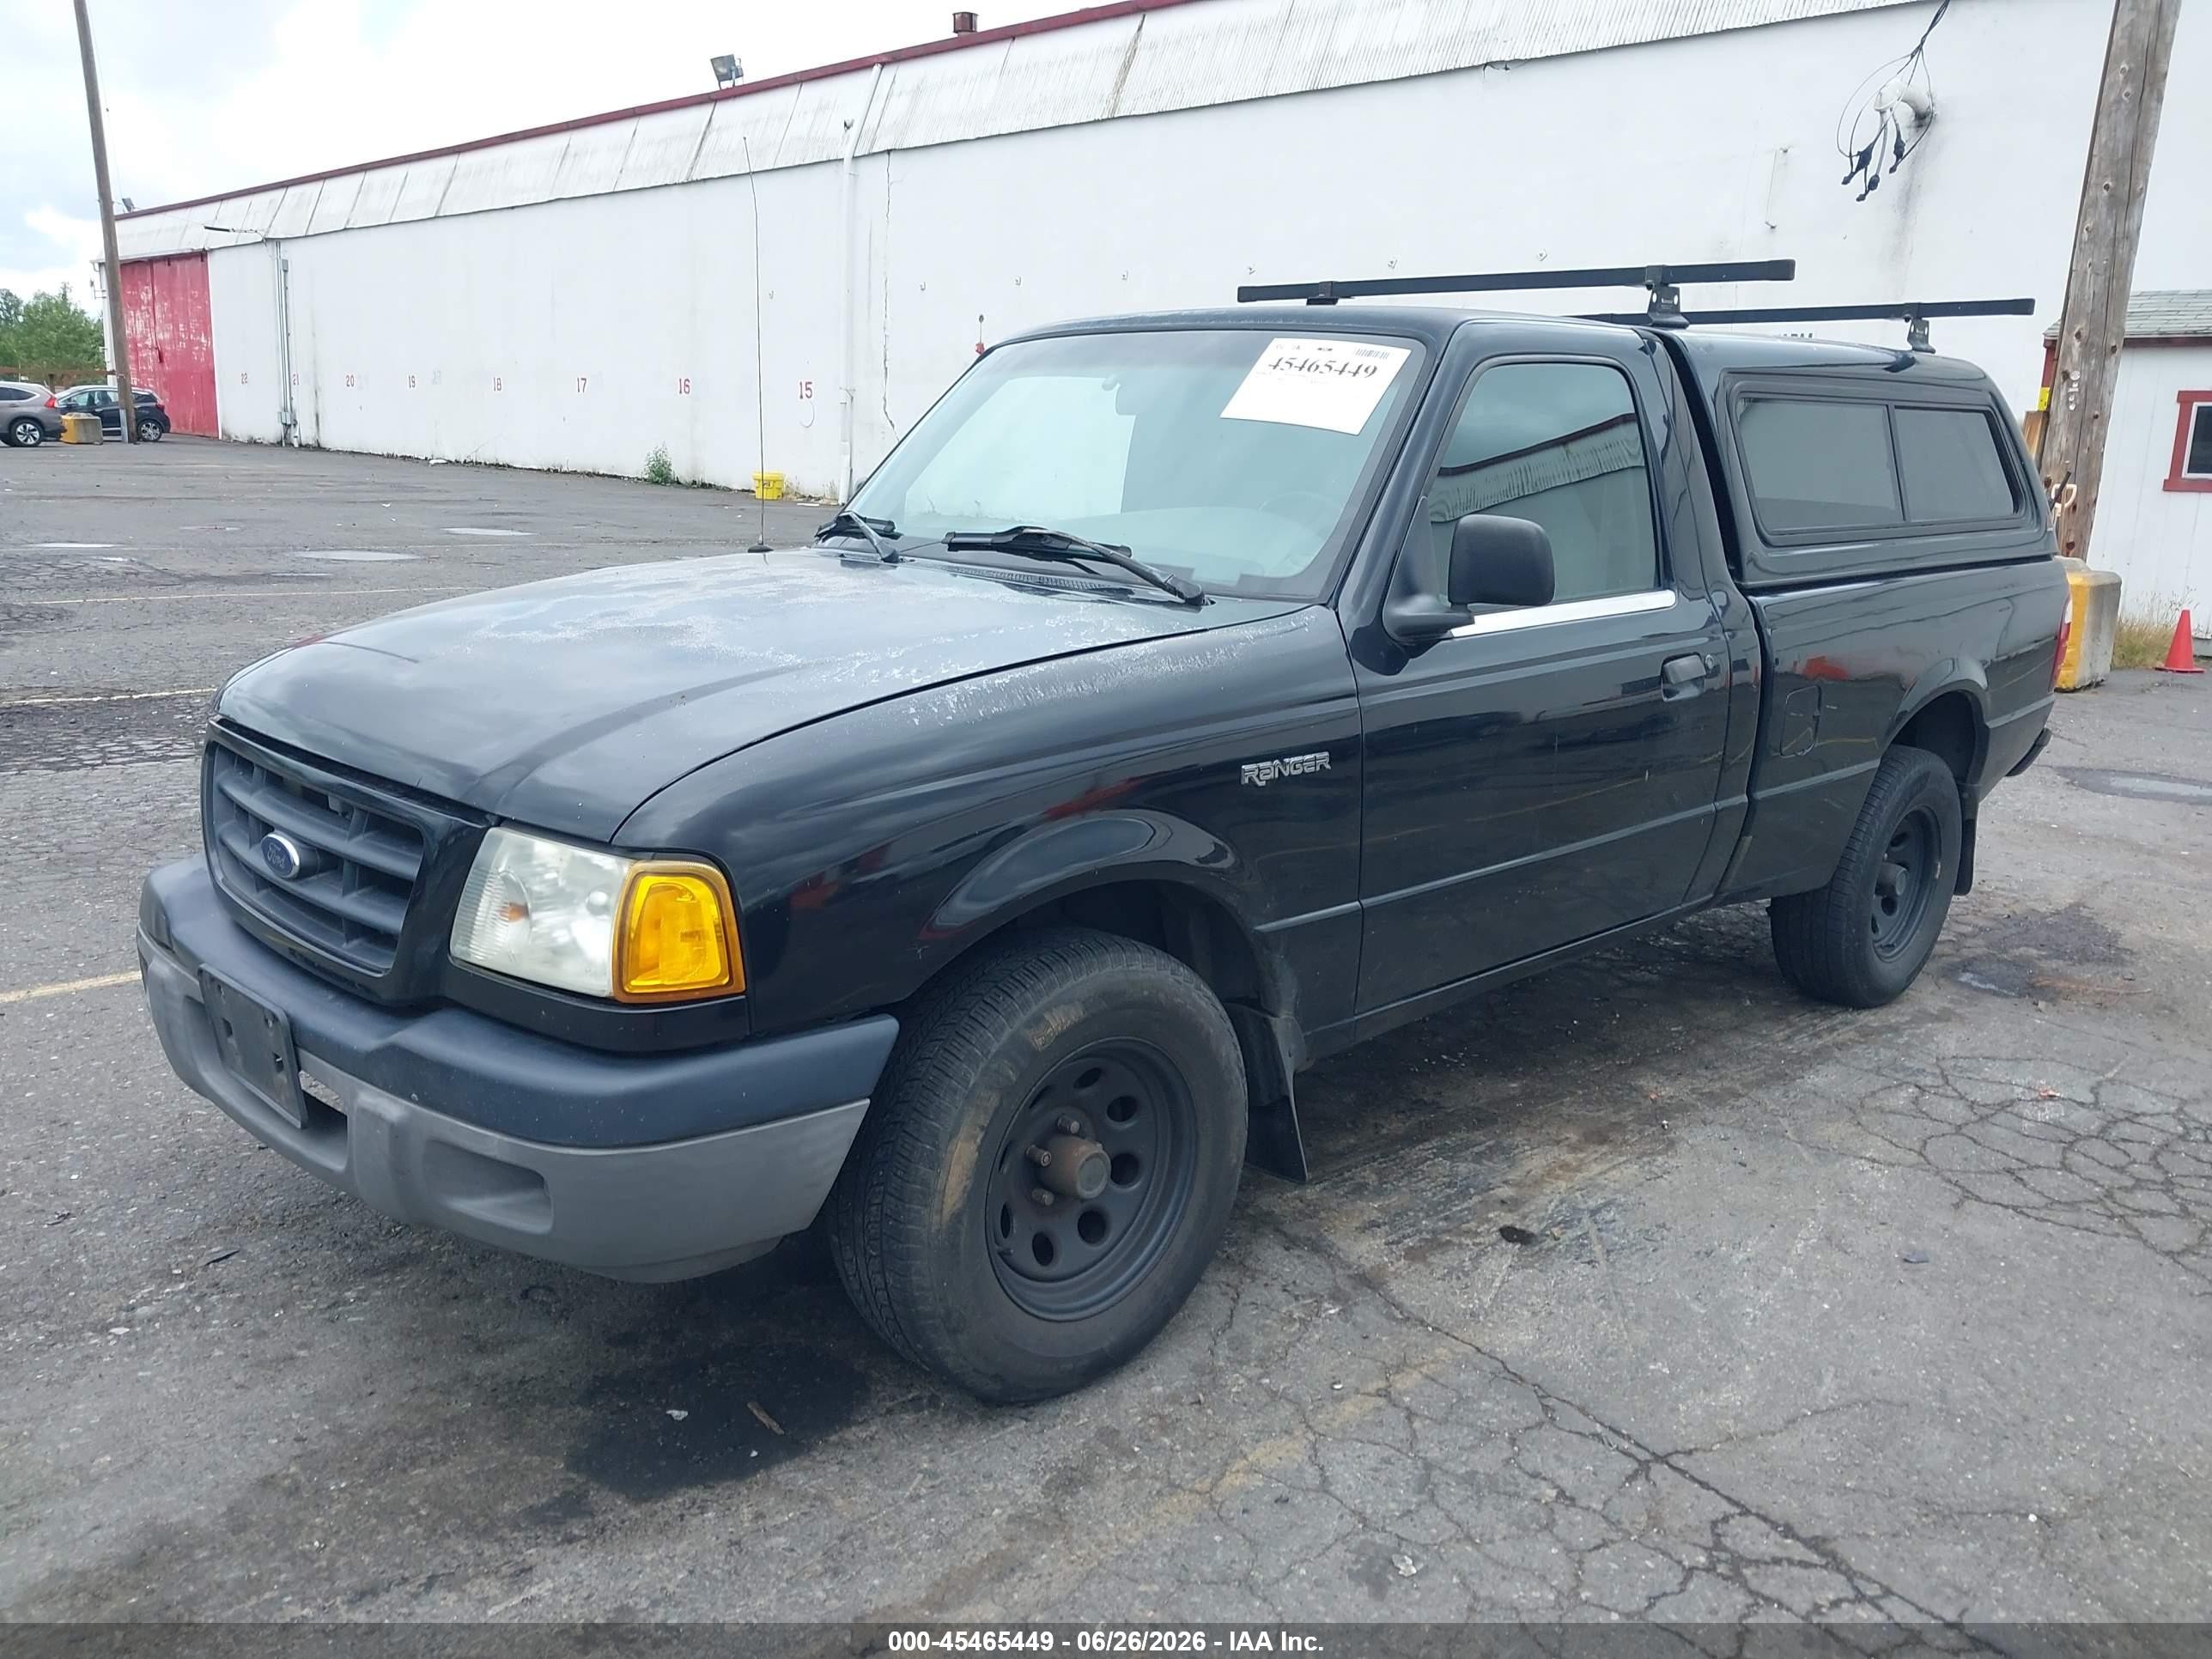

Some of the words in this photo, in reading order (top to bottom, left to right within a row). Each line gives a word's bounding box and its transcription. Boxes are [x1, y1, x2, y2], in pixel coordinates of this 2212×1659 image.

[1268, 357, 1377, 379] 45465449
[345, 374, 355, 387] 20
[408, 374, 416, 389] 19
[493, 377, 502, 392] 18
[577, 377, 587, 393] 17
[678, 378, 690, 394] 16
[799, 381, 813, 399] 15
